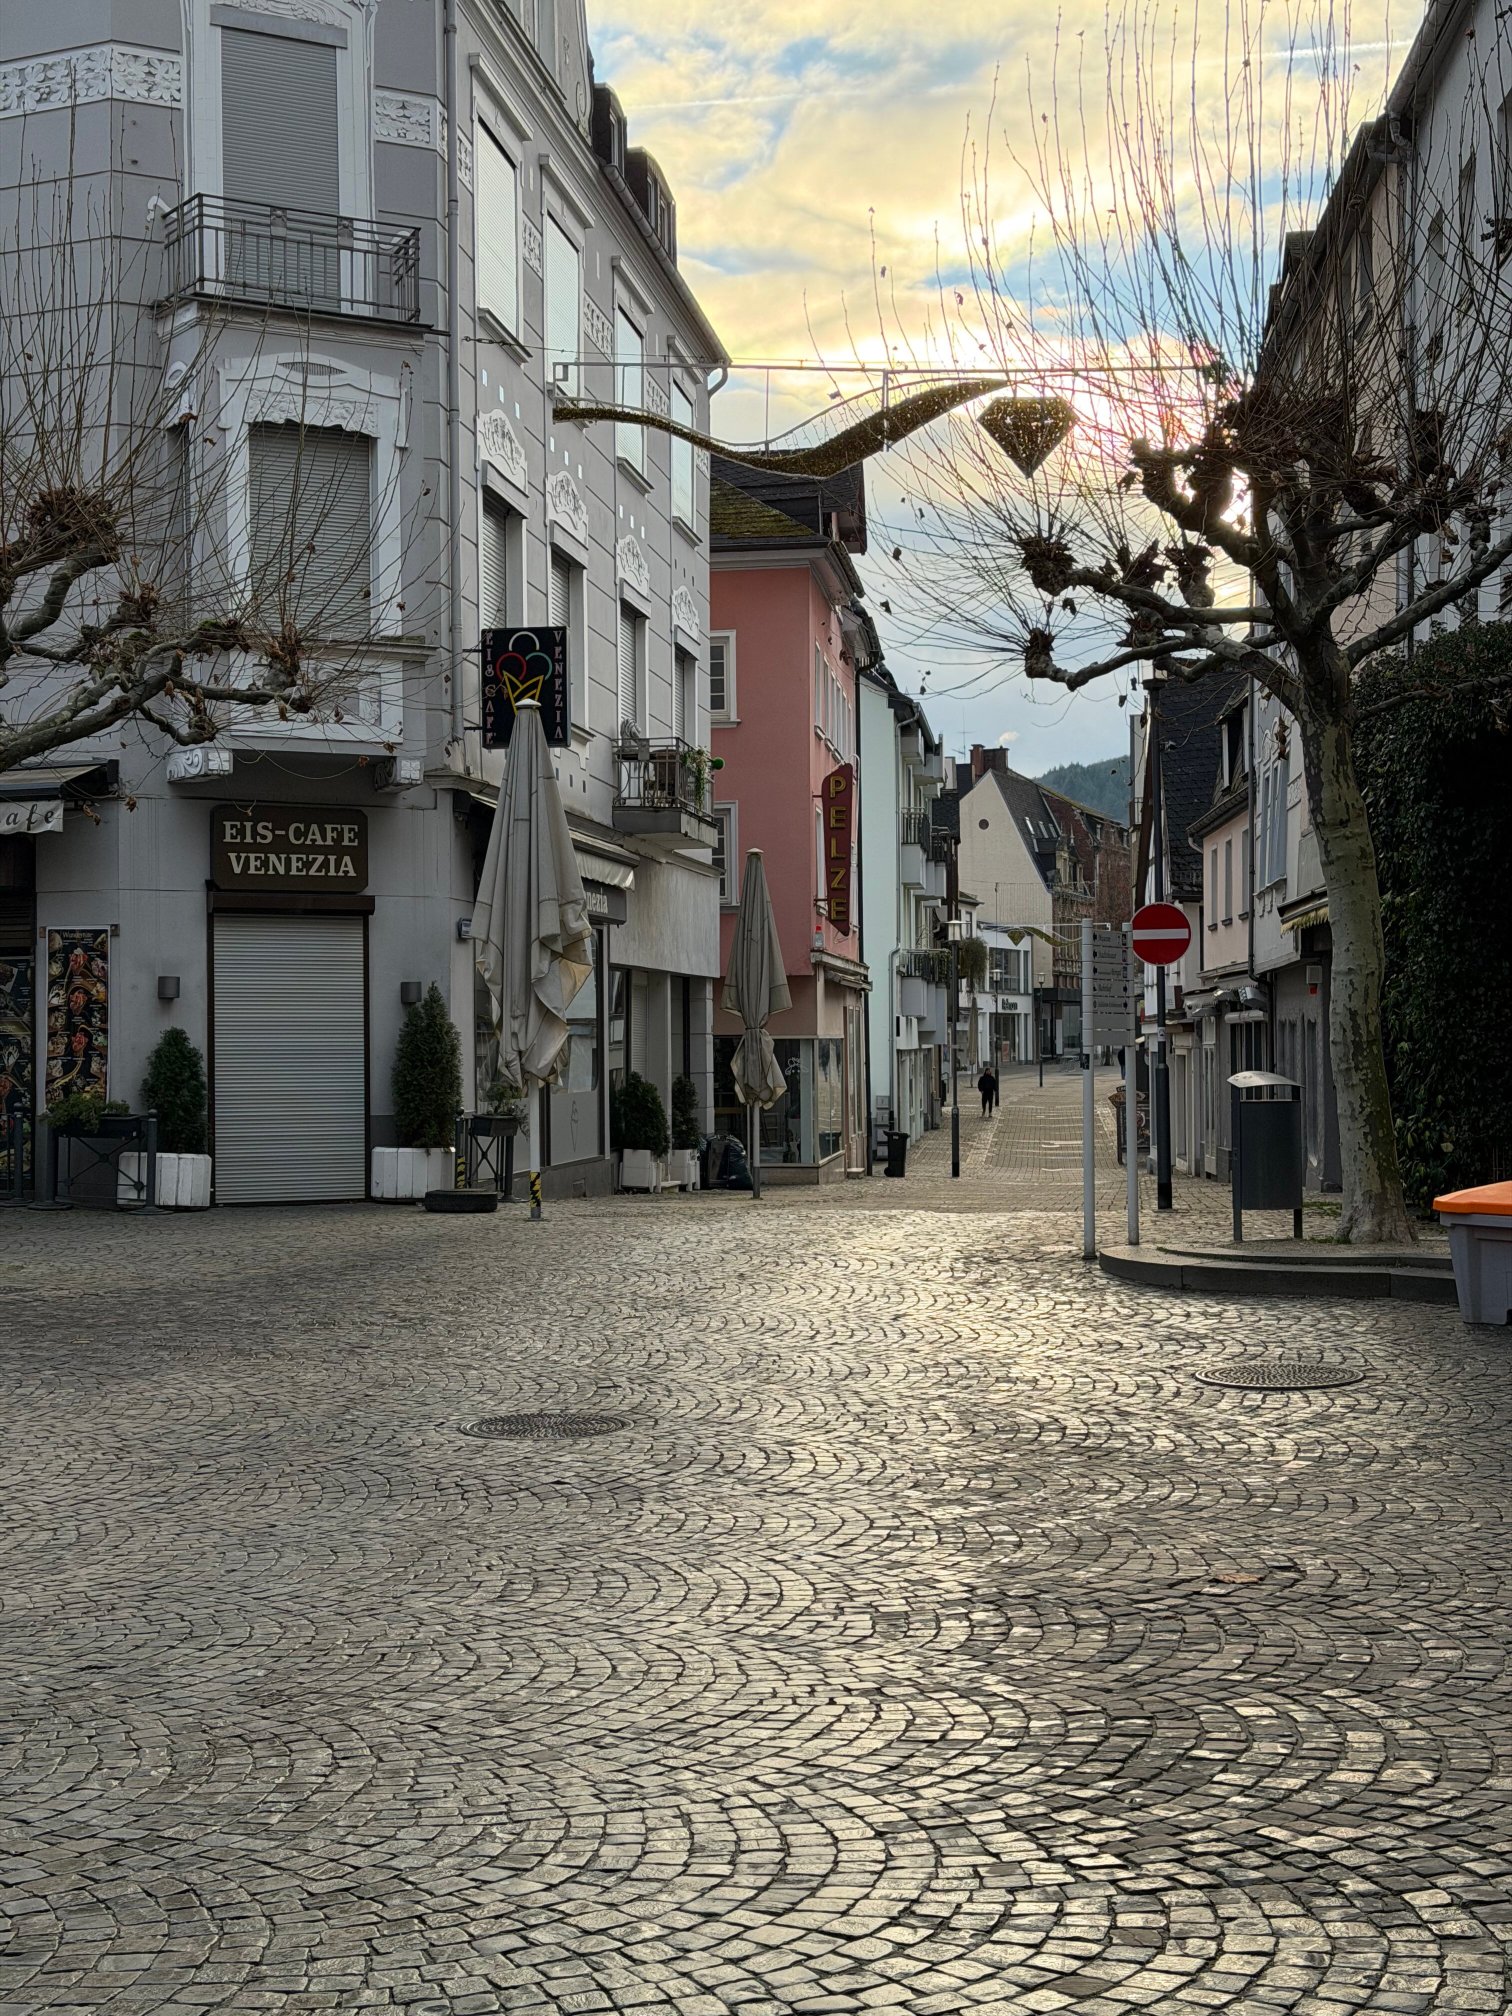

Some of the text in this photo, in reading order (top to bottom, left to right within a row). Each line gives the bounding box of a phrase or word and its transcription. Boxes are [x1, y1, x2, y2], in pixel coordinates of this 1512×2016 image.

[553, 630, 564, 739] VENEZIA
[0, 803, 54, 831] afe
[222, 820, 359, 847] EIS-CAFE
[829, 775, 848, 921] PELZE
[227, 852, 357, 877] VENEZIA
[586, 888, 609, 914] nezia
